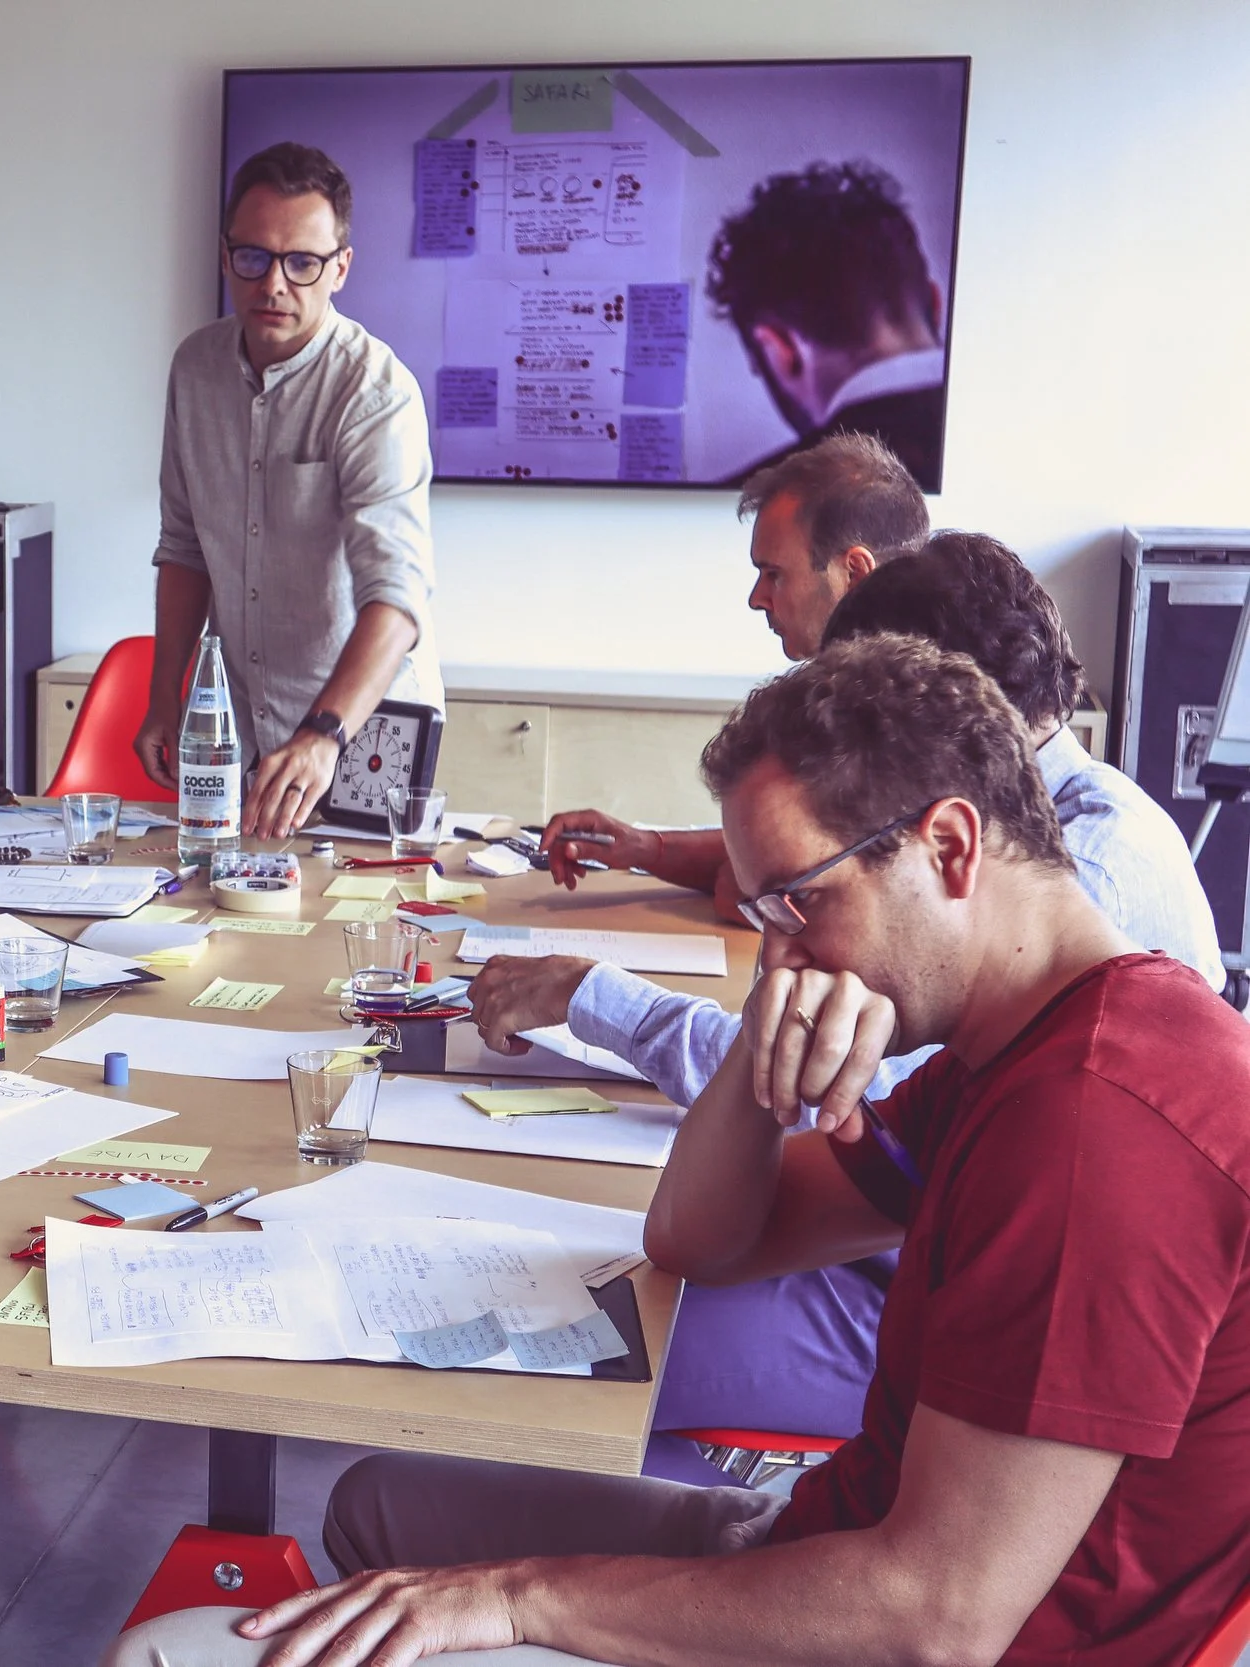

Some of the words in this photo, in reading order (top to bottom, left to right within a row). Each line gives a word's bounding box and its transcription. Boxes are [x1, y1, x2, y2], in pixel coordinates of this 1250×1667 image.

[523, 82, 590, 103] SAFARI
[392, 726, 401, 736] 55
[402, 742, 410, 752] 50
[402, 764, 411, 773] 45
[342, 774, 350, 783] 20
[184, 787, 191, 796] di
[193, 788, 225, 797] carnia
[351, 790, 359, 801] 25
[364, 799, 373, 808] 30
